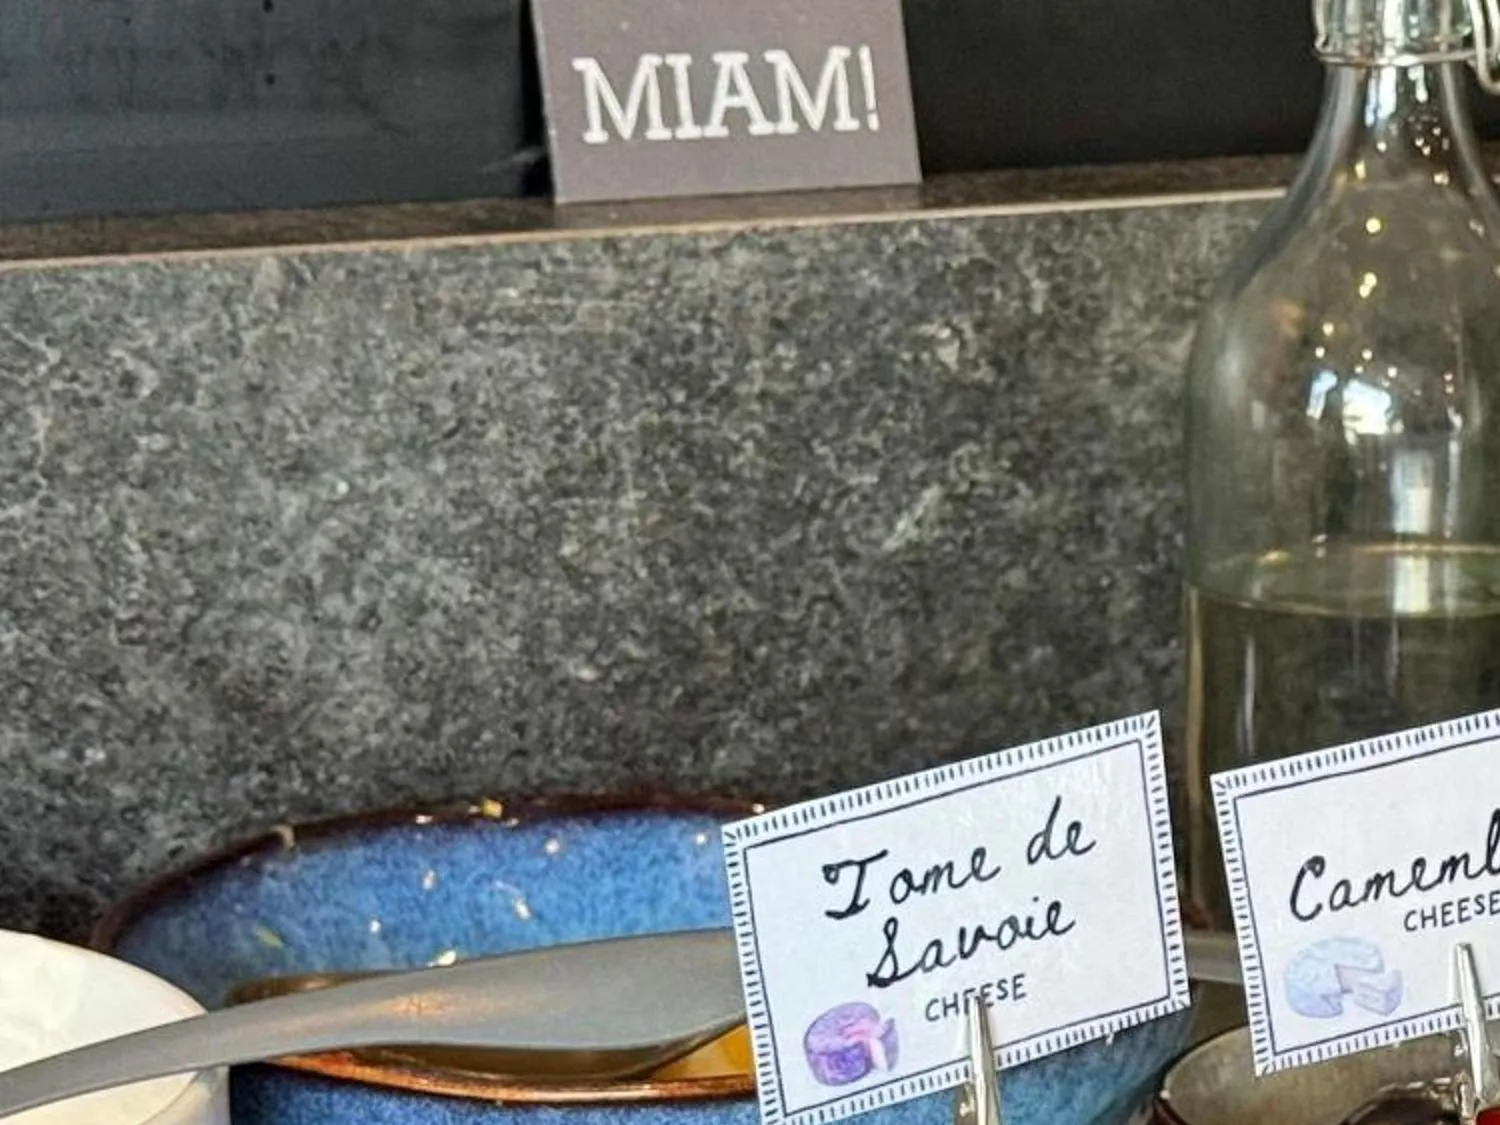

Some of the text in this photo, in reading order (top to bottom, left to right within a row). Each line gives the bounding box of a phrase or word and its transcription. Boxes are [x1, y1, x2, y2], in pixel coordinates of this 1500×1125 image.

[572, 45, 880, 144] MIAM!
[821, 795, 1096, 920] Tome de
[866, 895, 1077, 989] Savoie
